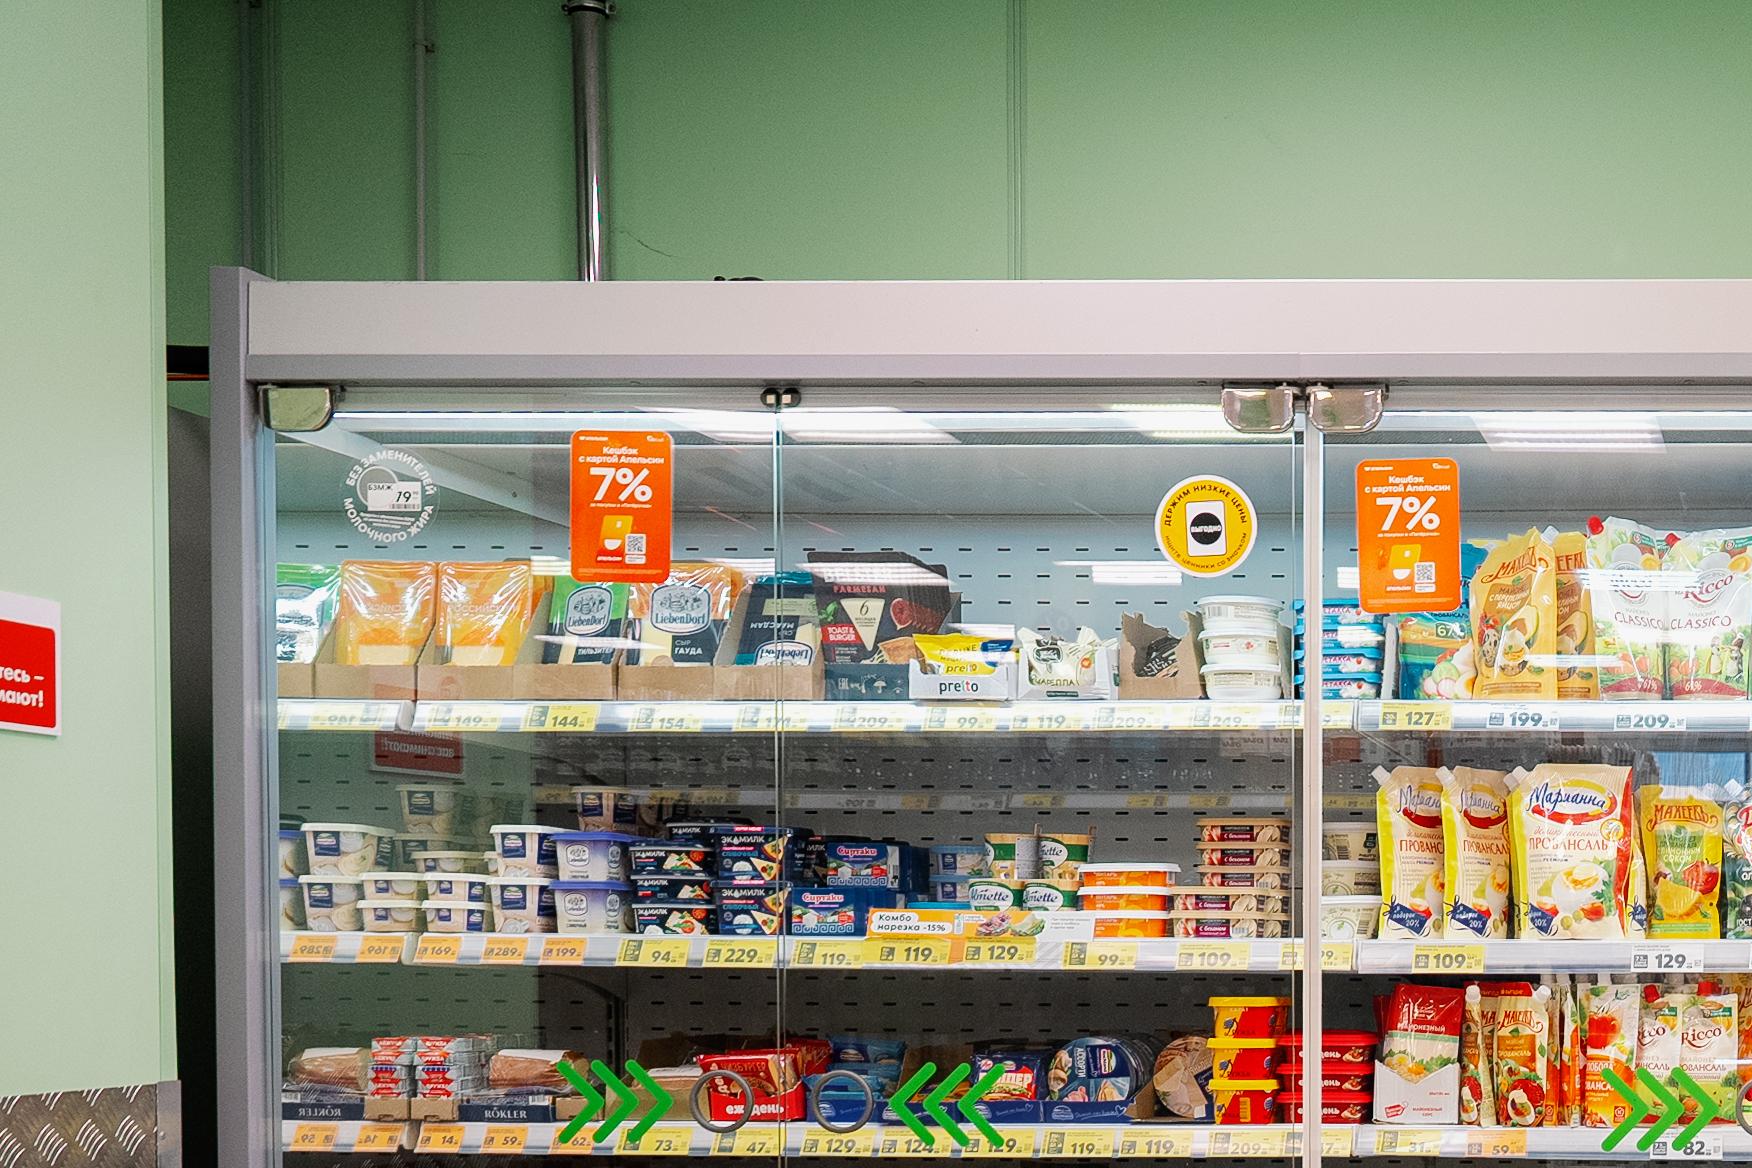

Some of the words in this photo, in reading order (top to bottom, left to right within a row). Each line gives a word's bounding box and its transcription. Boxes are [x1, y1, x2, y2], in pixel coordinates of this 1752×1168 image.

[603, 446, 639, 456] Кешбэк
[586, 455, 618, 465] картой
[619, 455, 665, 464] Апельсин
[345, 464, 365, 487] БЕЗ
[360, 449, 438, 497] ЗАМЕНИТЕЛЕЙ
[589, 467, 653, 502] 7%
[1388, 475, 1425, 486] Кешбэк
[1372, 485, 1404, 495] картой
[1405, 483, 1451, 494] Апельсин
[1164, 485, 1191, 527] ДЕРЖИМ
[1192, 484, 1231, 499] НИЗКИЕ
[1230, 496, 1248, 525] ЦЕНЫ
[342, 496, 409, 543] МОЛОЧНОГО
[406, 504, 435, 539] ЖИРА
[1376, 496, 1440, 531] 7%
[1178, 555, 1216, 570] ЦЕННИКИ
[655, 612, 706, 627] LiebenDorf
[1670, 615, 1732, 630] CLASSICO
[674, 646, 703, 655] ГАУДА
[551, 714, 578, 728] 144
[1405, 712, 1435, 726] 127
[1508, 713, 1541, 727] 199
[1632, 714, 1670, 728] 209
[1528, 781, 1606, 812] Марианна
[1529, 837, 1609, 851] ПРОВАНСАЛЬ
[836, 846, 878, 857] Сиртаки
[801, 892, 845, 903] Сиртаки
[878, 913, 912, 923] Комбо
[877, 923, 920, 932] нарезка
[724, 948, 758, 963] 229
[1433, 953, 1466, 968] 109
[1655, 953, 1687, 968] 129
[1681, 1027, 1722, 1046] Ricco
[826, 1138, 857, 1153] 129
[1144, 1140, 1175, 1154] 119
